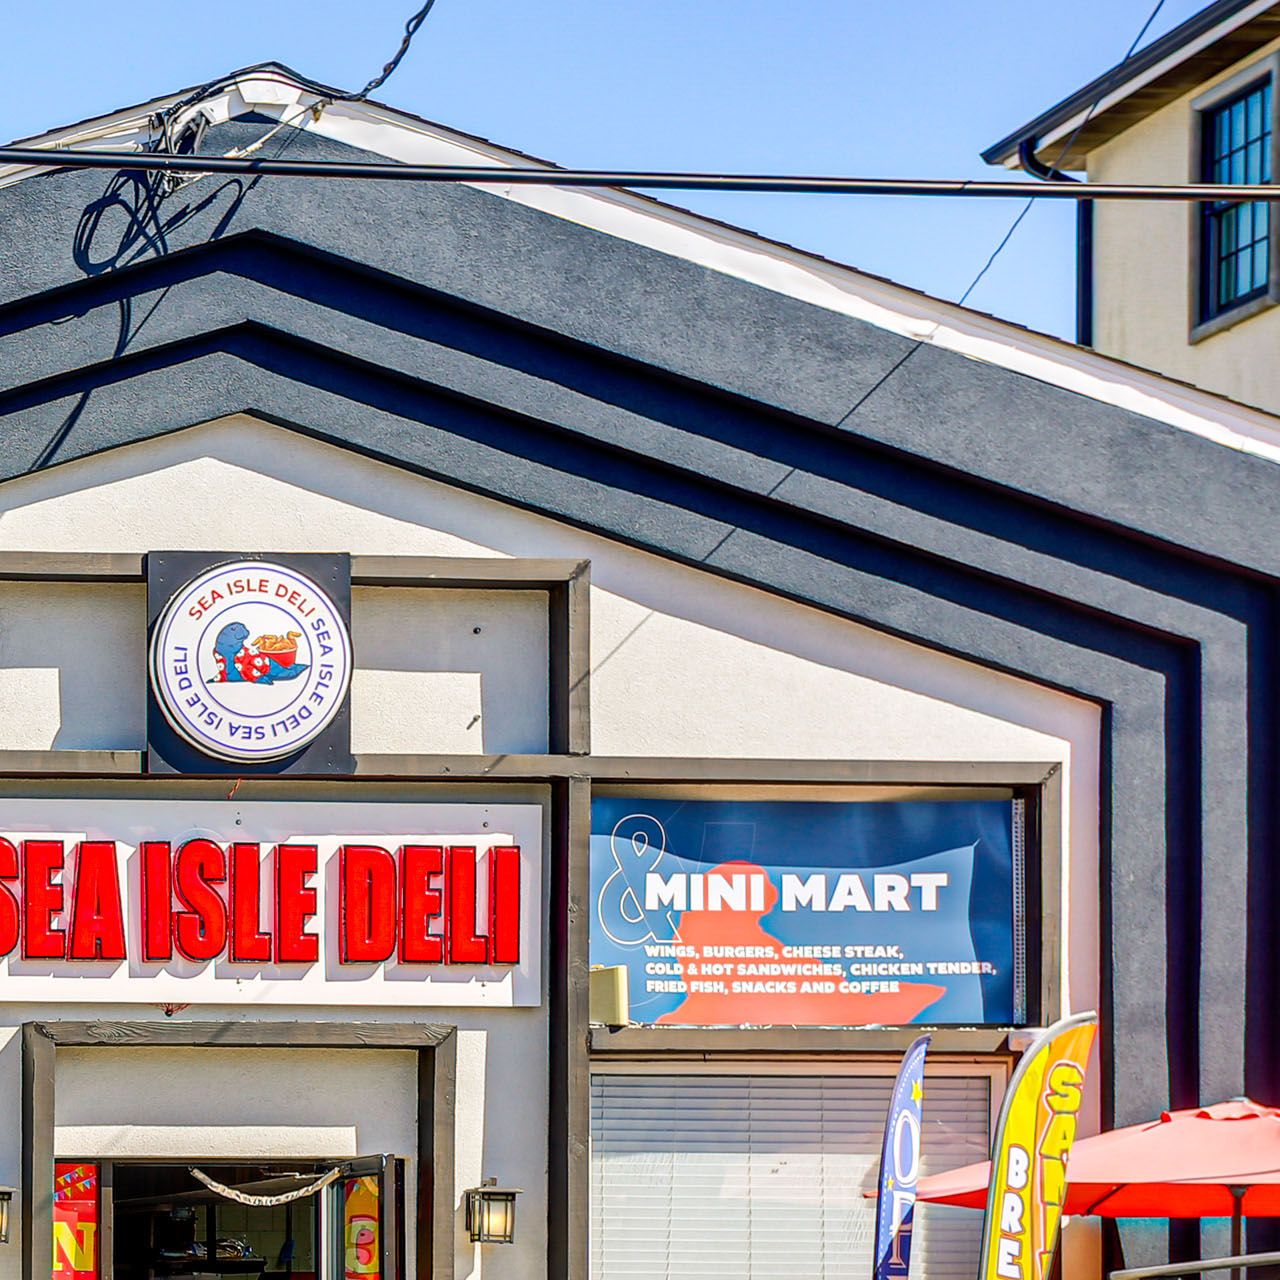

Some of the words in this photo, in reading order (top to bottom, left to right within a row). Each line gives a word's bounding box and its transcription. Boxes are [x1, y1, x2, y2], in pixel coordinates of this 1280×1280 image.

[189, 589, 224, 621] SEA
[226, 578, 269, 596] ISLE
[275, 583, 316, 618] DELI
[311, 617, 334, 657] SEA
[174, 645, 192, 691] DELI
[309, 663, 334, 706] ISLE
[186, 693, 224, 730] ISLE
[228, 721, 265, 740] SEA
[271, 705, 313, 737] DELI
[598, 813, 683, 945] &
[645, 872, 766, 912] MINI
[781, 872, 948, 912] MART
[142, 838, 318, 964] ISLE
[340, 844, 520, 966] DELI
[644, 945, 700, 959] WINGS,
[703, 946, 779, 960] BURGERS,
[782, 946, 841, 958] CHEESE
[844, 945, 904, 960] STEAK,
[645, 963, 684, 975] COLD
[687, 963, 698, 975] &
[701, 963, 734, 975] HOT
[737, 963, 846, 977] SANDWICHES,
[850, 963, 923, 976] CHICKEN
[926, 962, 997, 976] TENDER,
[646, 980, 688, 993] FRIED
[690, 981, 729, 995] FISH,
[732, 981, 796, 993] SNACKS
[800, 981, 835, 993] AND
[839, 981, 900, 993] COFFEE
